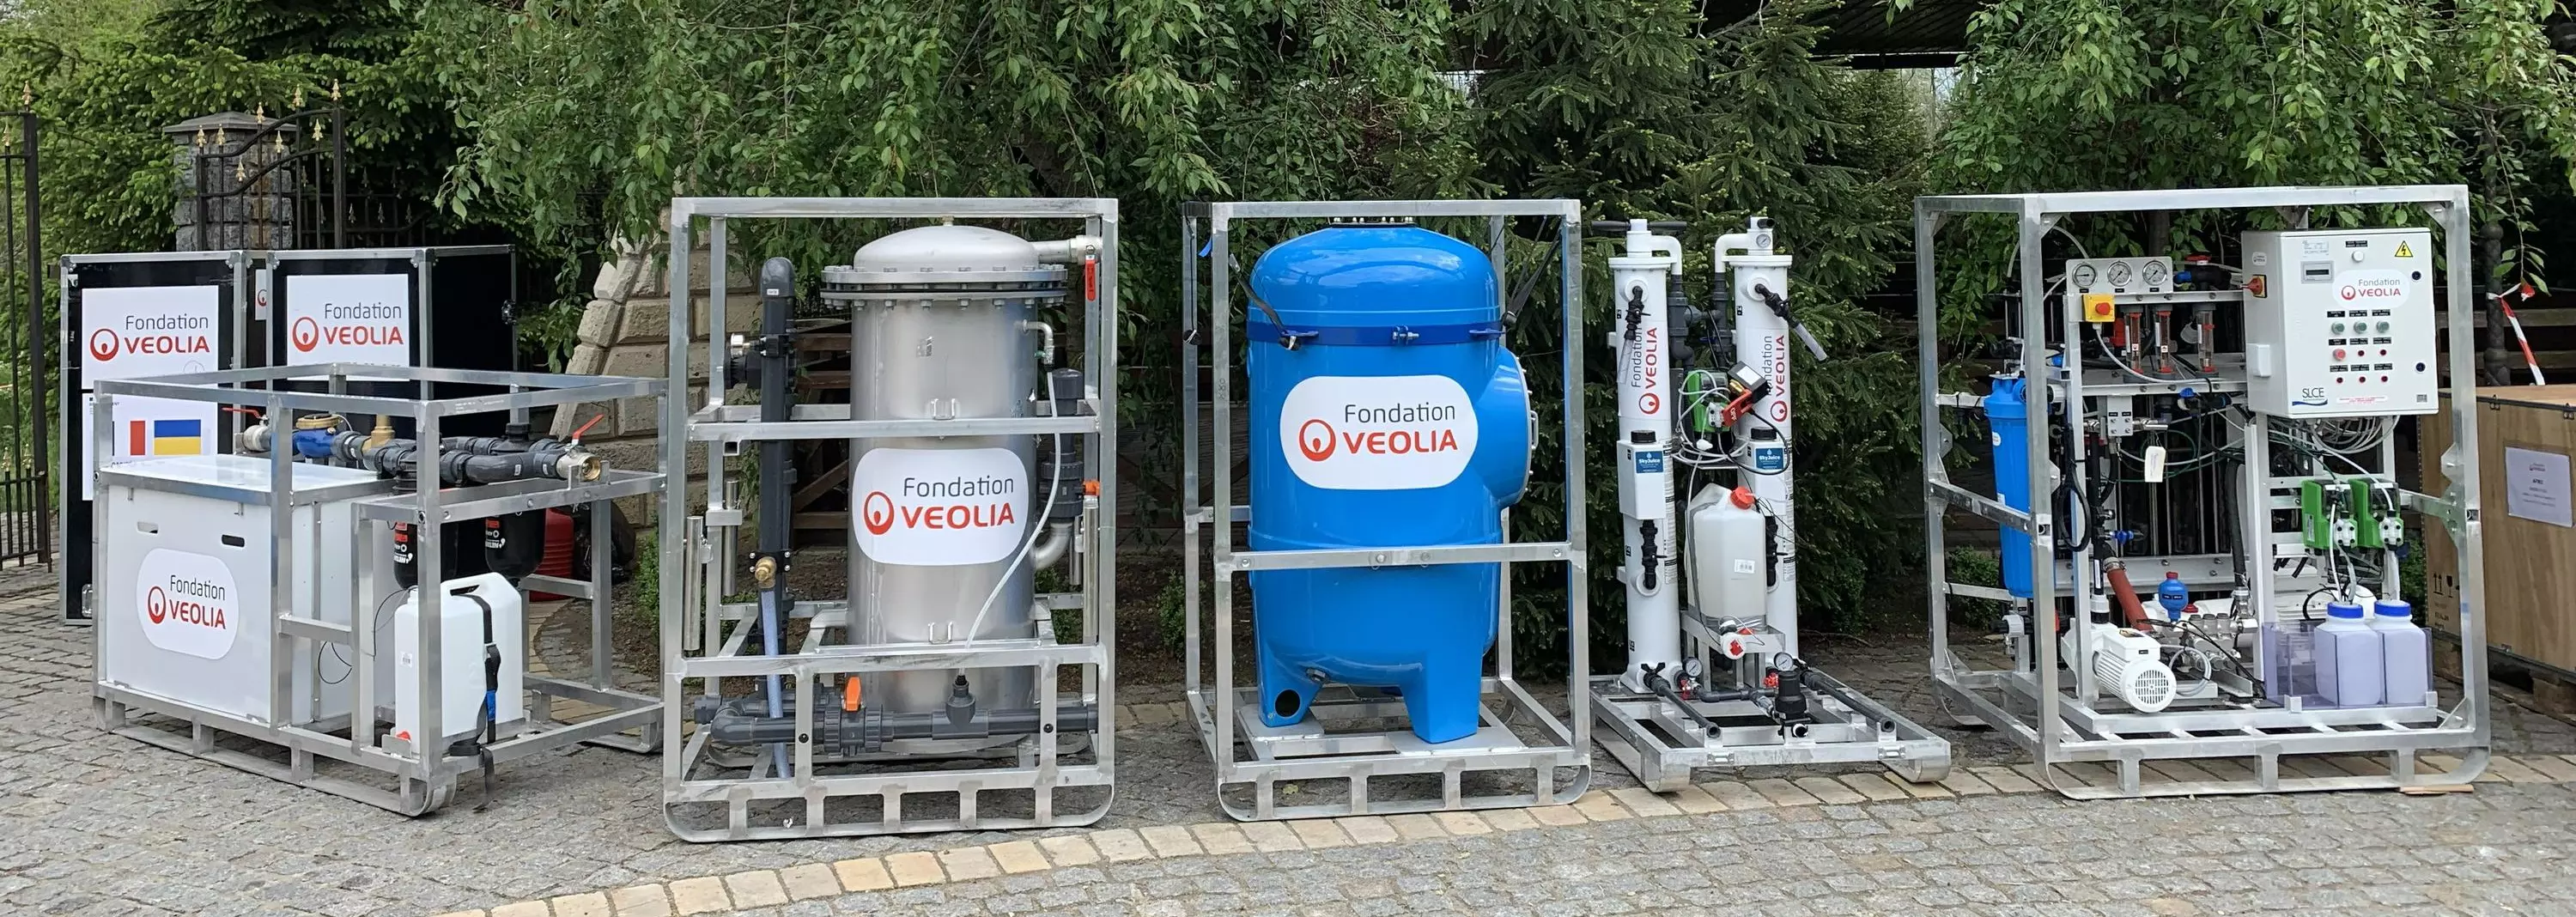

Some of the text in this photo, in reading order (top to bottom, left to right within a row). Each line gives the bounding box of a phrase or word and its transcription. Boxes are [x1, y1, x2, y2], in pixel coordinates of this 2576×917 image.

[2357, 288, 2402, 298] VEOLIA
[2358, 278, 2401, 288] Fondation
[325, 302, 402, 319] Fondation
[125, 313, 209, 331] Fondation
[124, 336, 210, 354] VEOLIA
[323, 325, 404, 345] VEOLIA
[1645, 327, 1657, 389] VEOLIA
[1776, 335, 1785, 397] VEOLIA
[2302, 387, 2324, 399] SLCE
[1345, 402, 1455, 423] Fondation
[1342, 428, 1458, 454] VEOLIA
[903, 475, 1014, 497] Fondation
[901, 502, 1015, 529] VEOLIA
[170, 574, 226, 601] Fondation
[169, 599, 226, 630] VEOLIA
